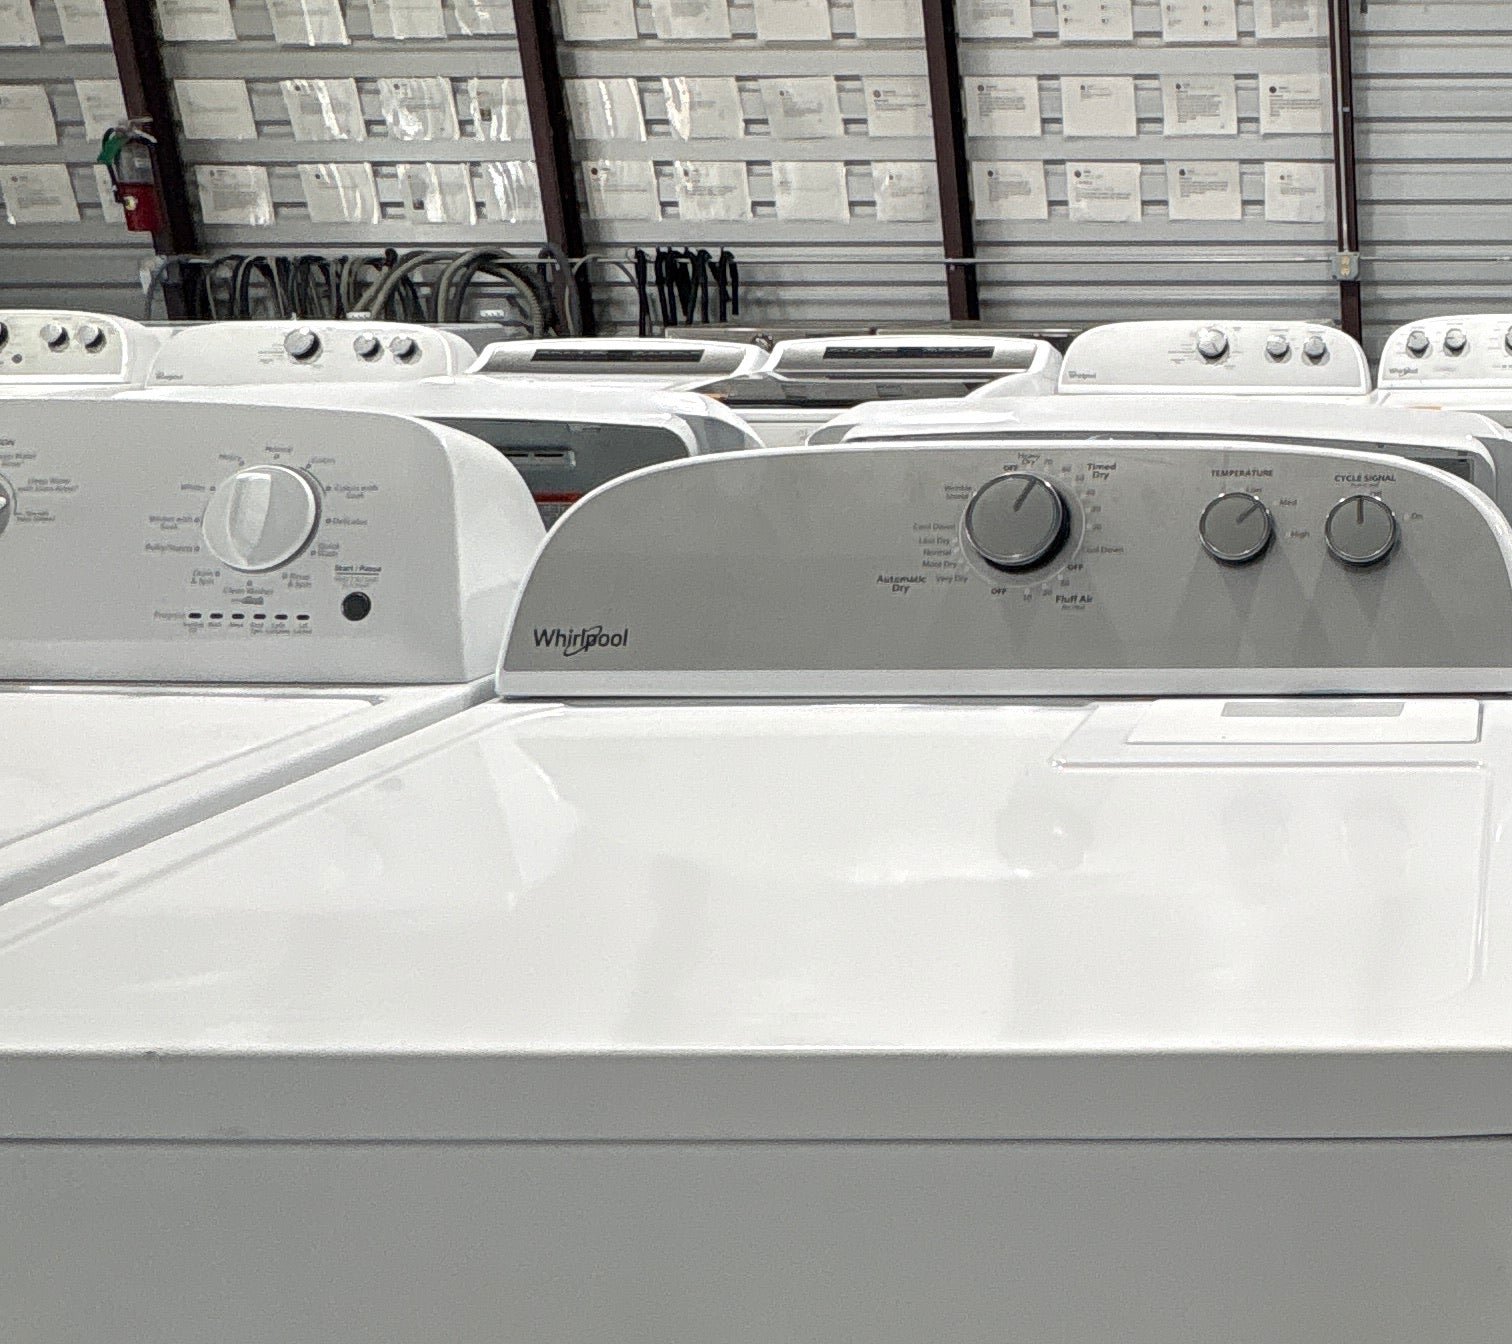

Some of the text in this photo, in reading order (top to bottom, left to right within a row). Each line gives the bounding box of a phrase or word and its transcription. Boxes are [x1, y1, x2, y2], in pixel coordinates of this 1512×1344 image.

[1003, 464, 1019, 472] OFF
[1087, 461, 1116, 472] Timed
[1091, 471, 1110, 481] Dry
[1211, 469, 1273, 478] TEMPERATURE
[1334, 474, 1396, 484] CYCLE SIGNAL
[942, 559, 957, 569] Dry
[1067, 563, 1083, 571] OFF
[876, 574, 927, 585] Automatic
[891, 584, 910, 594] Dry
[991, 587, 1007, 595] OFF
[1055, 594, 1093, 604] Fluff Air
[533, 626, 629, 655] Whirlpool
